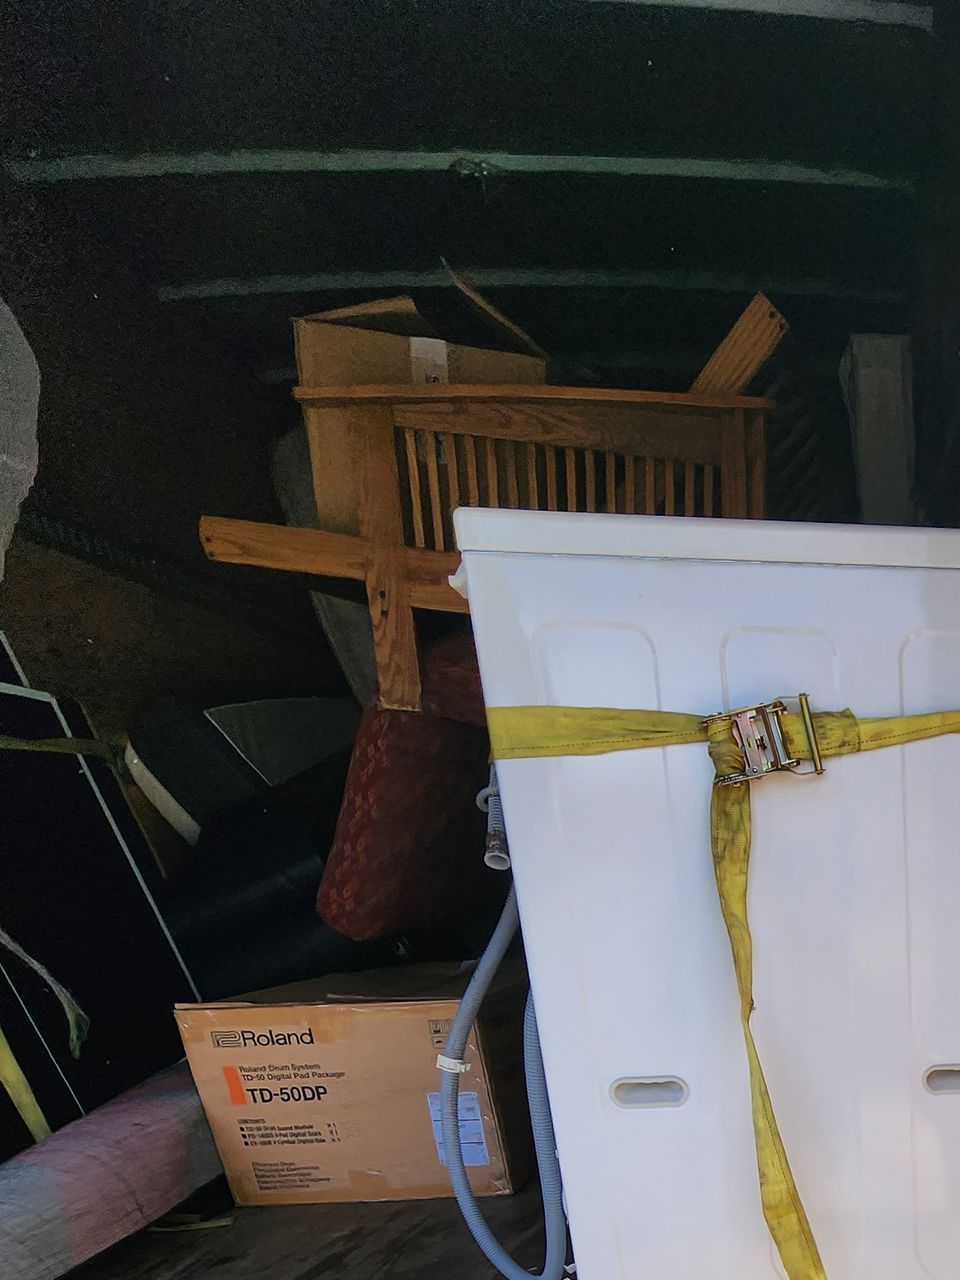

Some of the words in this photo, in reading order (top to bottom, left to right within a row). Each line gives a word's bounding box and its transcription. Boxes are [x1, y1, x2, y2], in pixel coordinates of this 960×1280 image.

[240, 1028, 315, 1047] Roland
[239, 1065, 267, 1073] Roland
[268, 1064, 290, 1072] Drum
[291, 1063, 320, 1072] System
[267, 1072, 292, 1081] Digital
[294, 1071, 309, 1079] Pad
[312, 1071, 345, 1080] Package
[246, 1085, 328, 1104] TD-50DP
